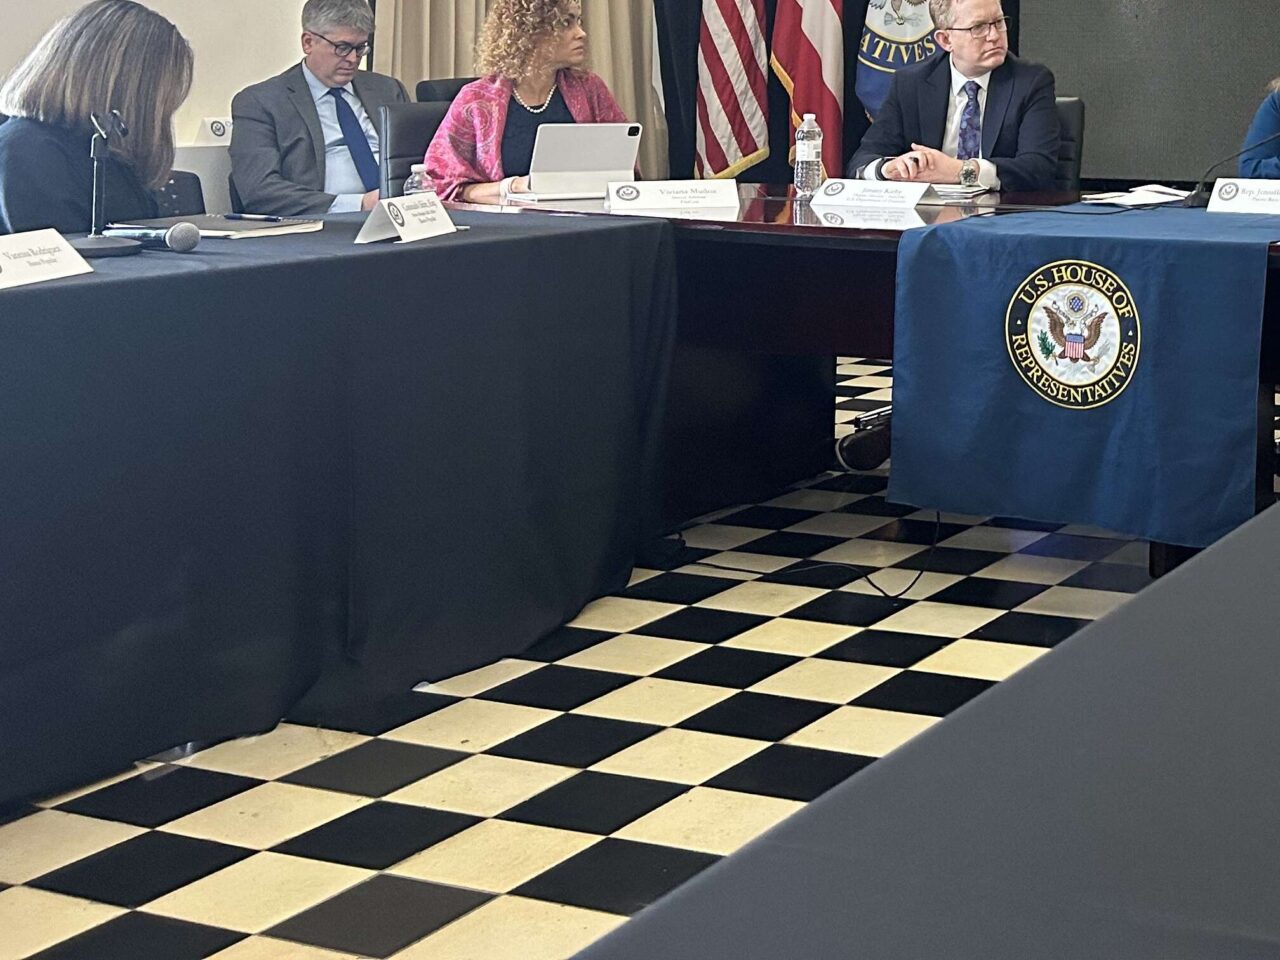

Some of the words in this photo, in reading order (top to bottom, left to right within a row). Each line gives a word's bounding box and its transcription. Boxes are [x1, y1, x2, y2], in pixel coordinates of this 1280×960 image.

[1018, 275, 1052, 304] U.S.
[1051, 265, 1117, 296] HOUSE
[1112, 291, 1134, 318] OF
[1012, 333, 1135, 403] REPRESENTATIVES
